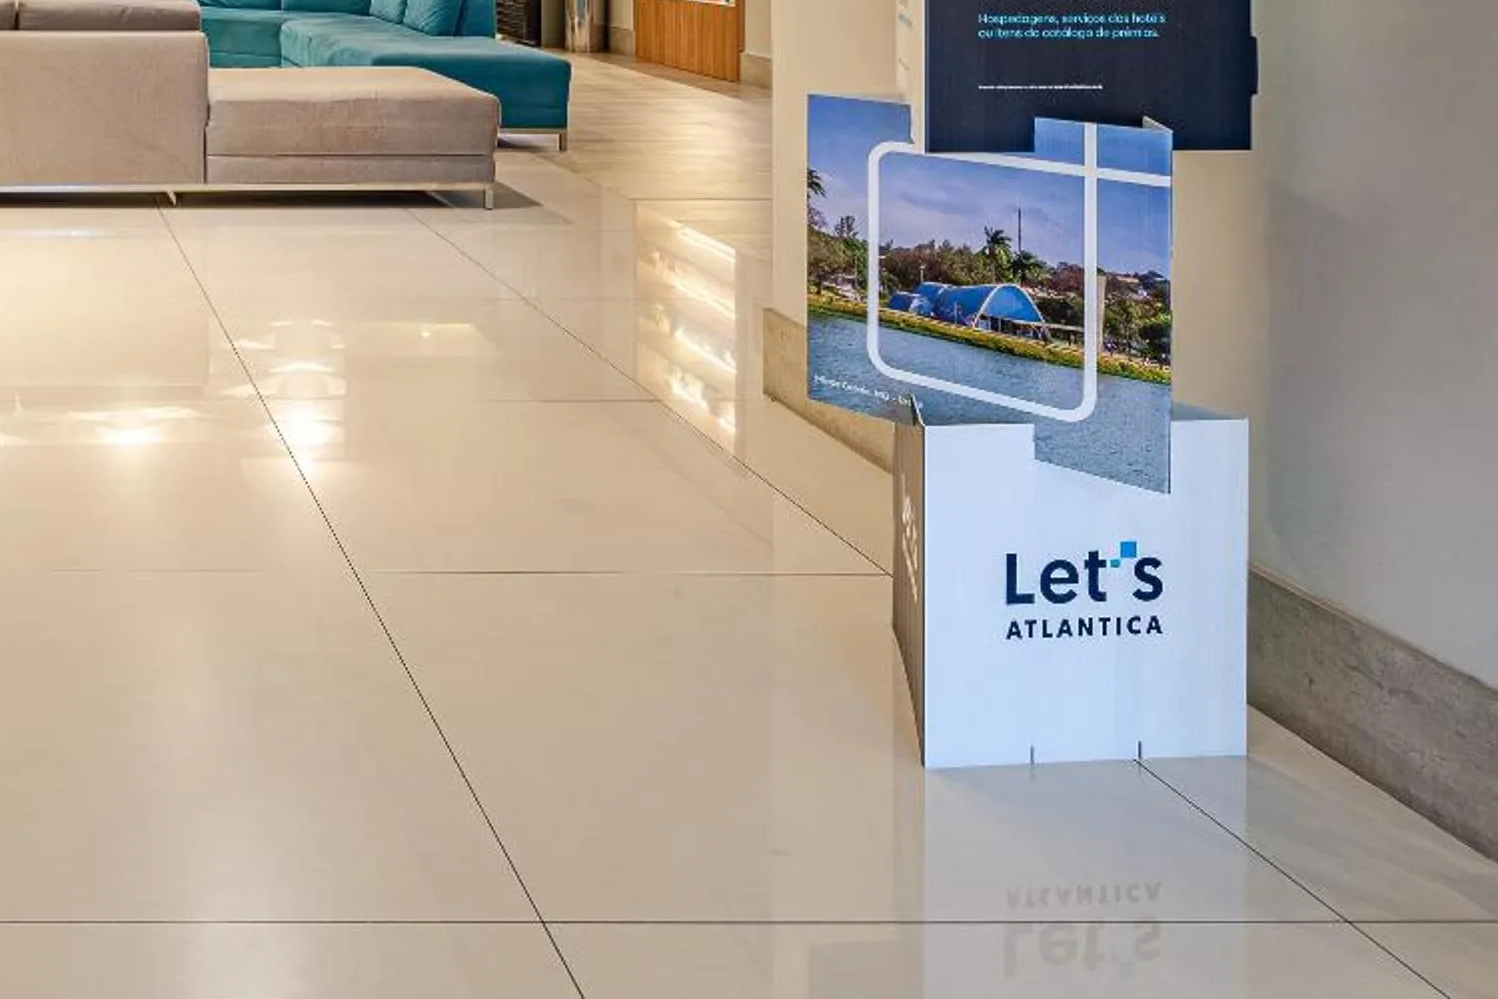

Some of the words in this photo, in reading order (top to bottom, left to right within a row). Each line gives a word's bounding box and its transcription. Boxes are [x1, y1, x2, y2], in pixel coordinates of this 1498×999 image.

[978, 30, 994, 38] ou
[1096, 26, 1111, 37] de
[1006, 541, 1163, 605] Let's
[1006, 615, 1163, 639] ATLANTICA
